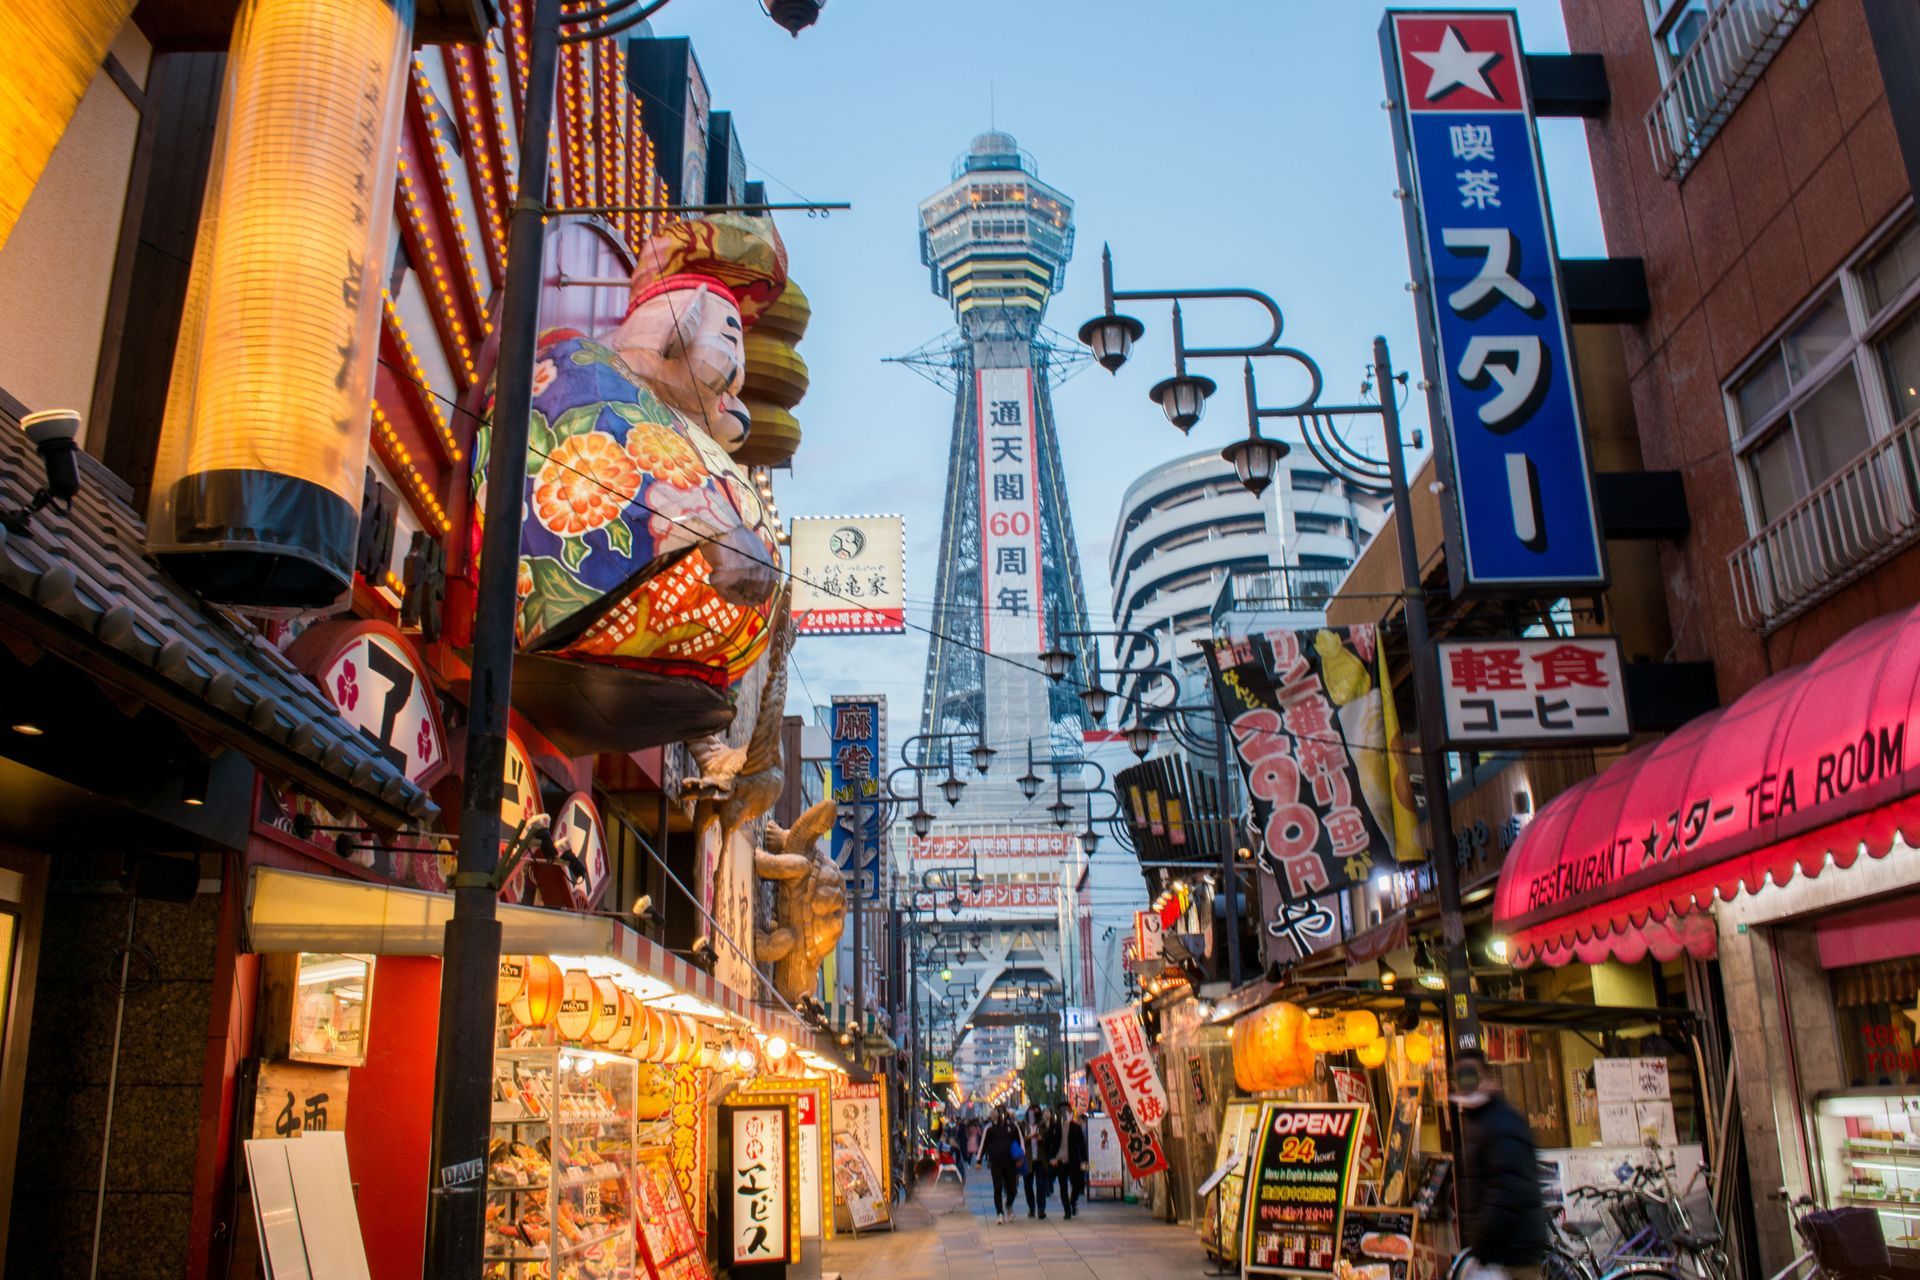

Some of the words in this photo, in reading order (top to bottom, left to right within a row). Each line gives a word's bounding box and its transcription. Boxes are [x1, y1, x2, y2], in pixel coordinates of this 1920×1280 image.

[1449, 124, 1501, 209] 喫茶
[1442, 228, 1545, 545] スター
[990, 401, 1032, 617] 通天閣60周年
[807, 611, 886, 627] 24時間営業中
[1449, 644, 1610, 693] 軽食
[834, 704, 873, 781] 麻雀
[1460, 694, 1610, 731] コーヒー
[1231, 708, 1330, 898] 290円
[1528, 836, 1633, 912] RESTAURANT
[1746, 768, 1798, 830] TEA
[1814, 722, 1906, 804] ROOM
[1274, 1113, 1351, 1137] OPEN!
[1279, 1136, 1315, 1163] 24
[1314, 1151, 1335, 1164] hours
[443, 1159, 482, 1186] DAVE
